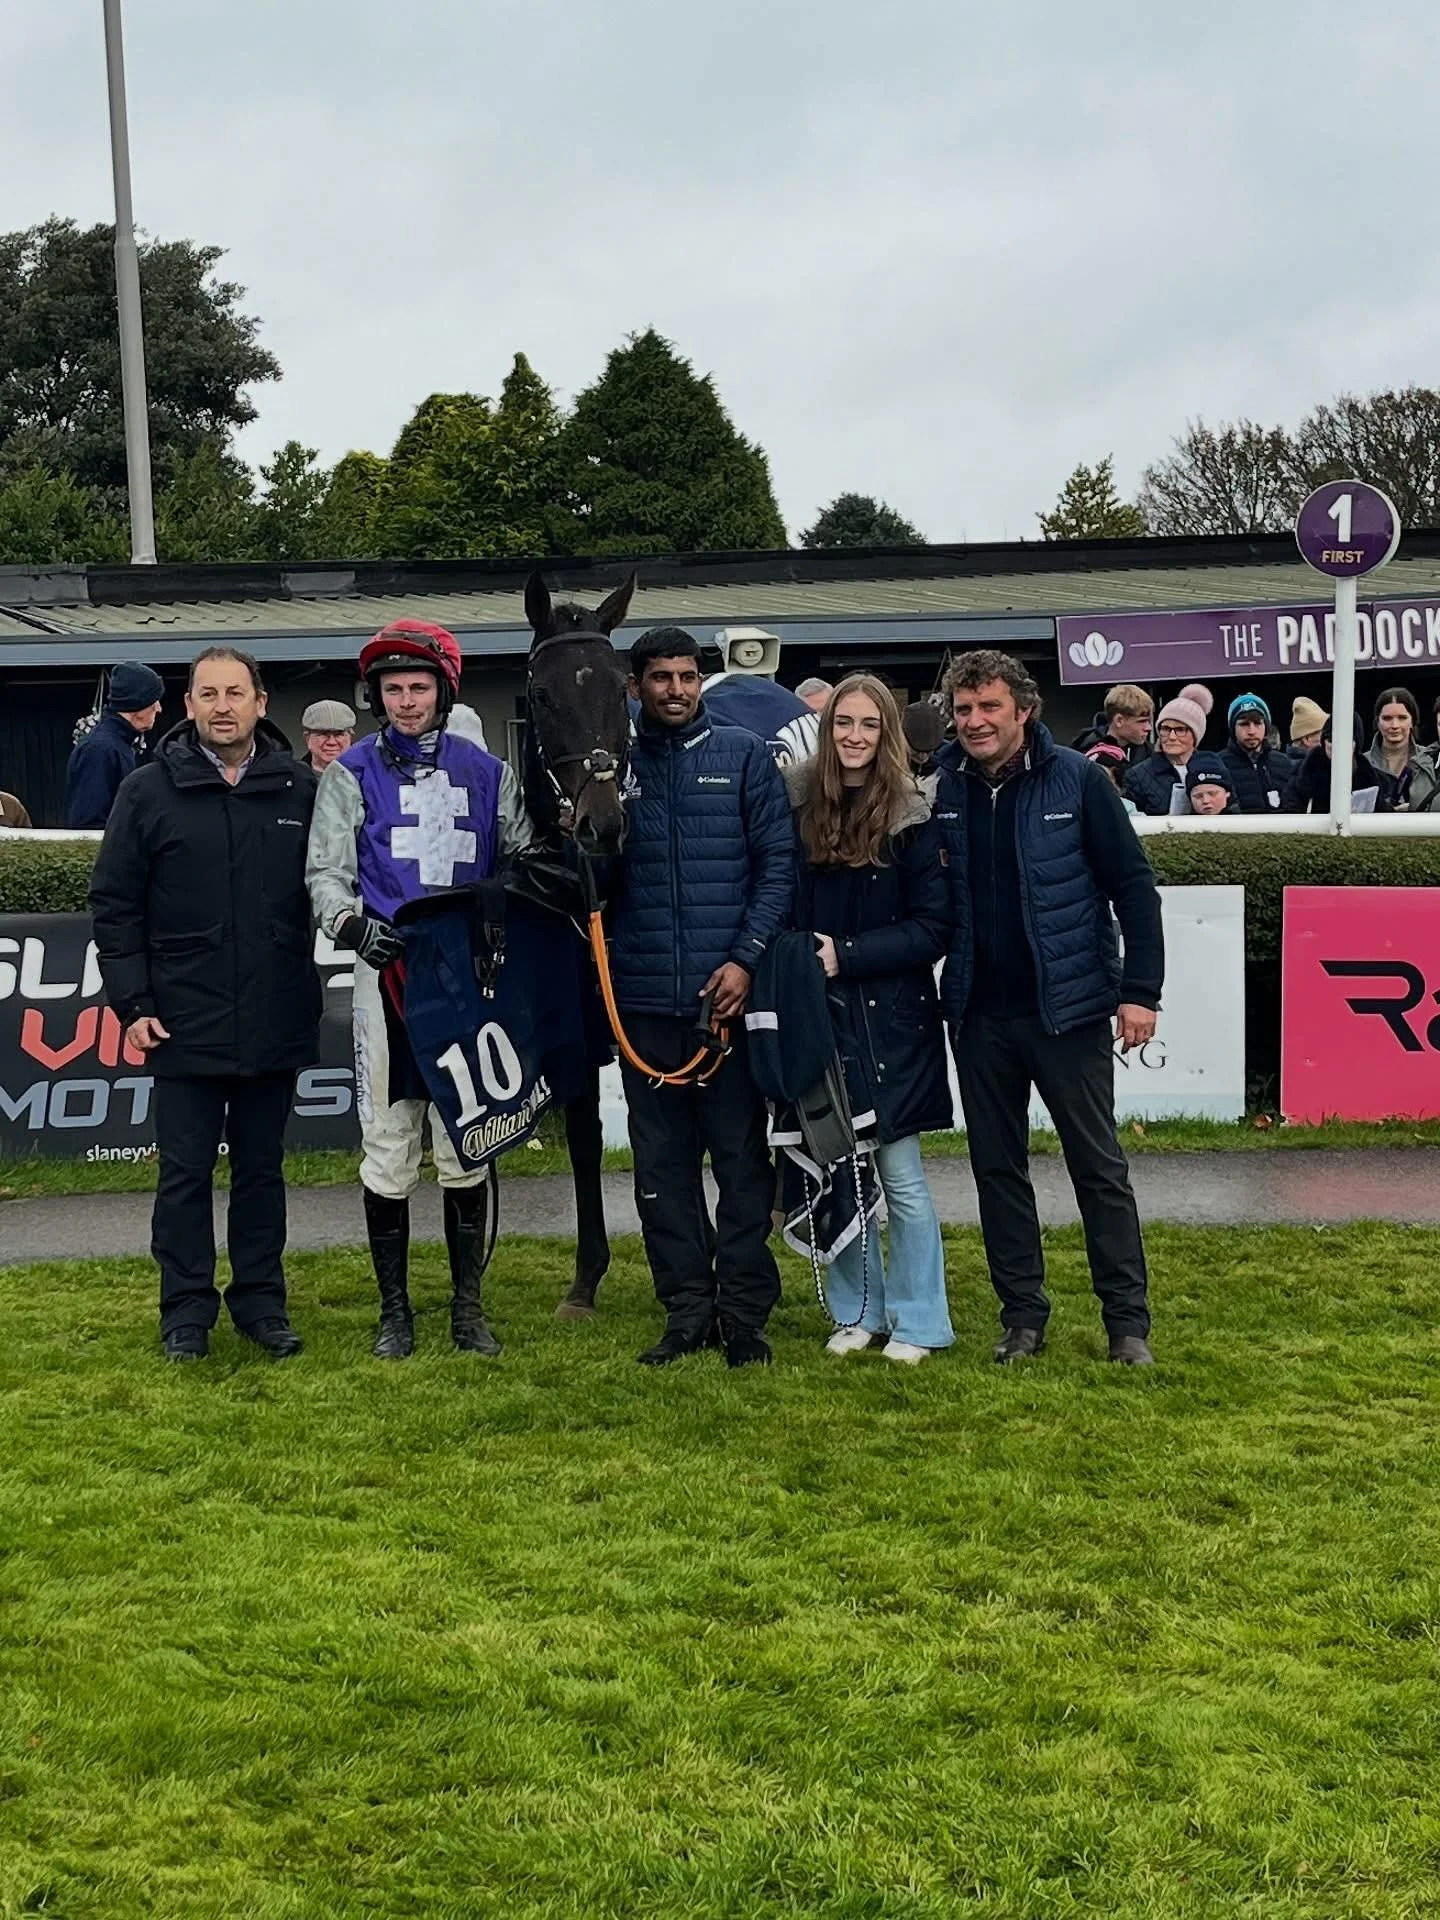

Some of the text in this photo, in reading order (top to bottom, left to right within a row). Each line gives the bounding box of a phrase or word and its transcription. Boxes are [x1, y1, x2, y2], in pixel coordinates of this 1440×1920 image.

[1327, 493, 1353, 543] 1
[1321, 550, 1365, 564] FIRST
[1219, 624, 1264, 658] THE
[436, 1021, 523, 1128] 10
